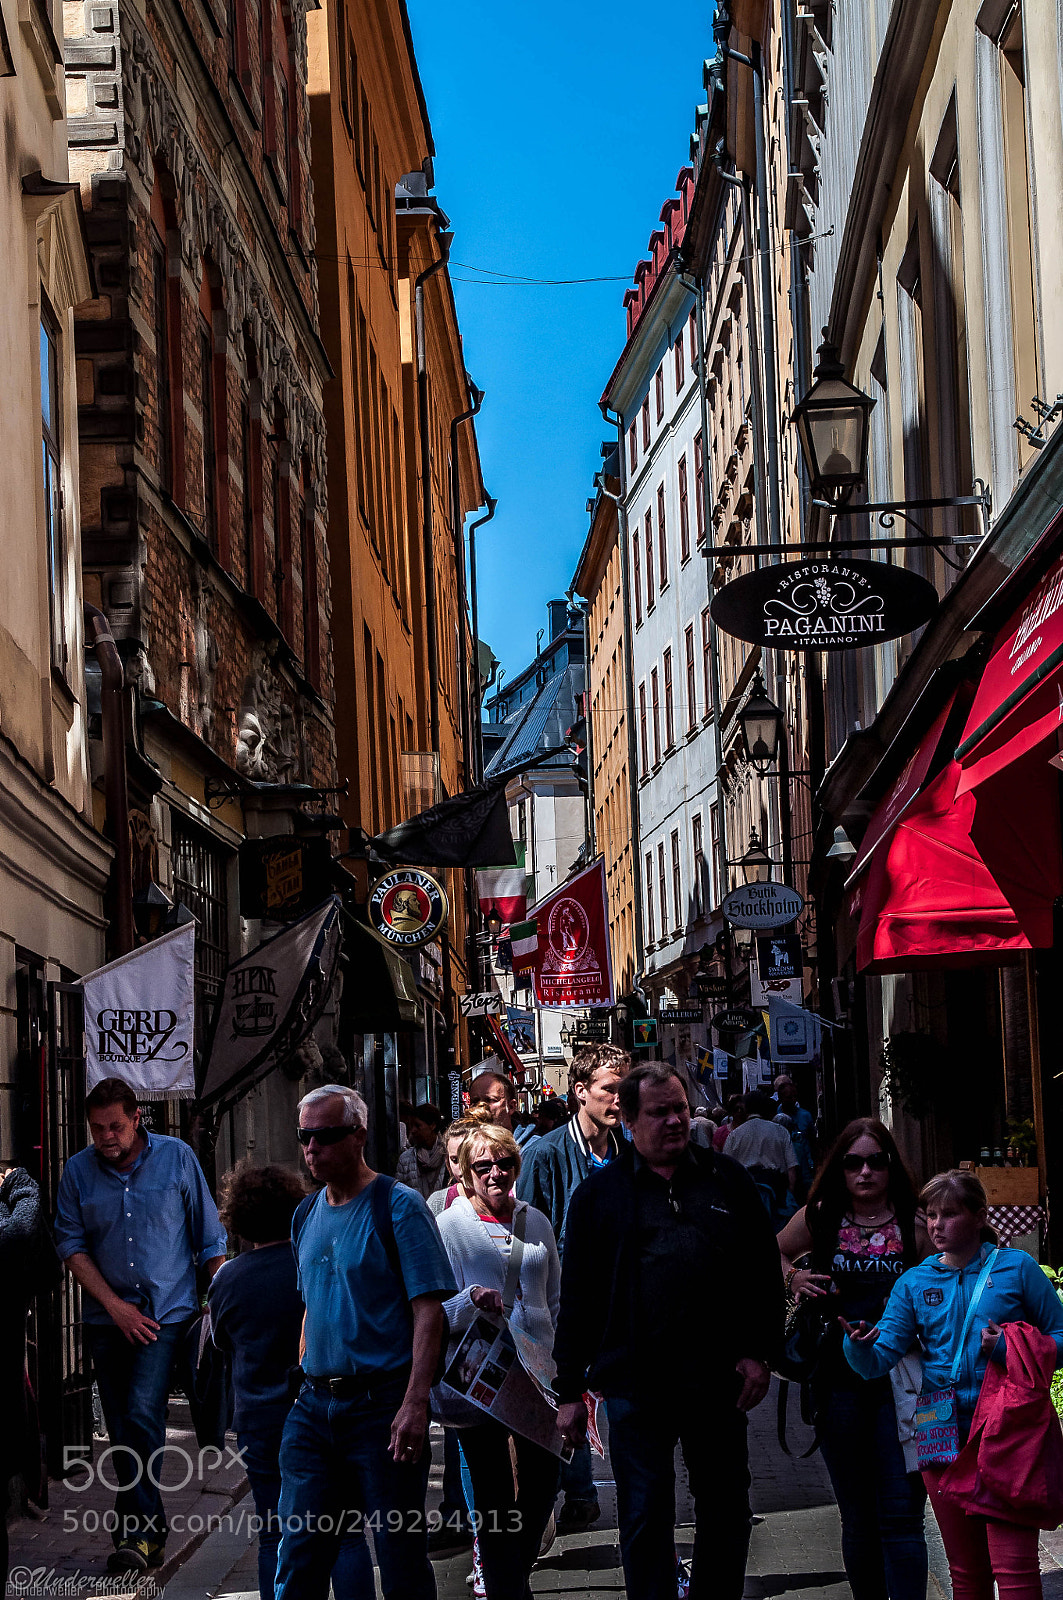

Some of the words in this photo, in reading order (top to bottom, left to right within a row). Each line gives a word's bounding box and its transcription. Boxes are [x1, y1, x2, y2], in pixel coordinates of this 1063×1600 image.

[779, 564, 868, 589] RISTORANTE
[763, 614, 886, 637] PAGANINI
[799, 636, 853, 645] ITALIANO
[371, 872, 440, 904] PAULANER
[747, 886, 777, 899] Butik
[727, 898, 801, 919] Stockholm
[377, 921, 437, 944] MÜNCHEN
[542, 976, 600, 985] MICHELANGELO
[543, 987, 602, 997] Ristorante
[460, 993, 501, 1017] Steps
[97, 1008, 177, 1034] GERD
[97, 1027, 189, 1063] INEZ
[98, 1055, 141, 1063] BOUTIQUE
